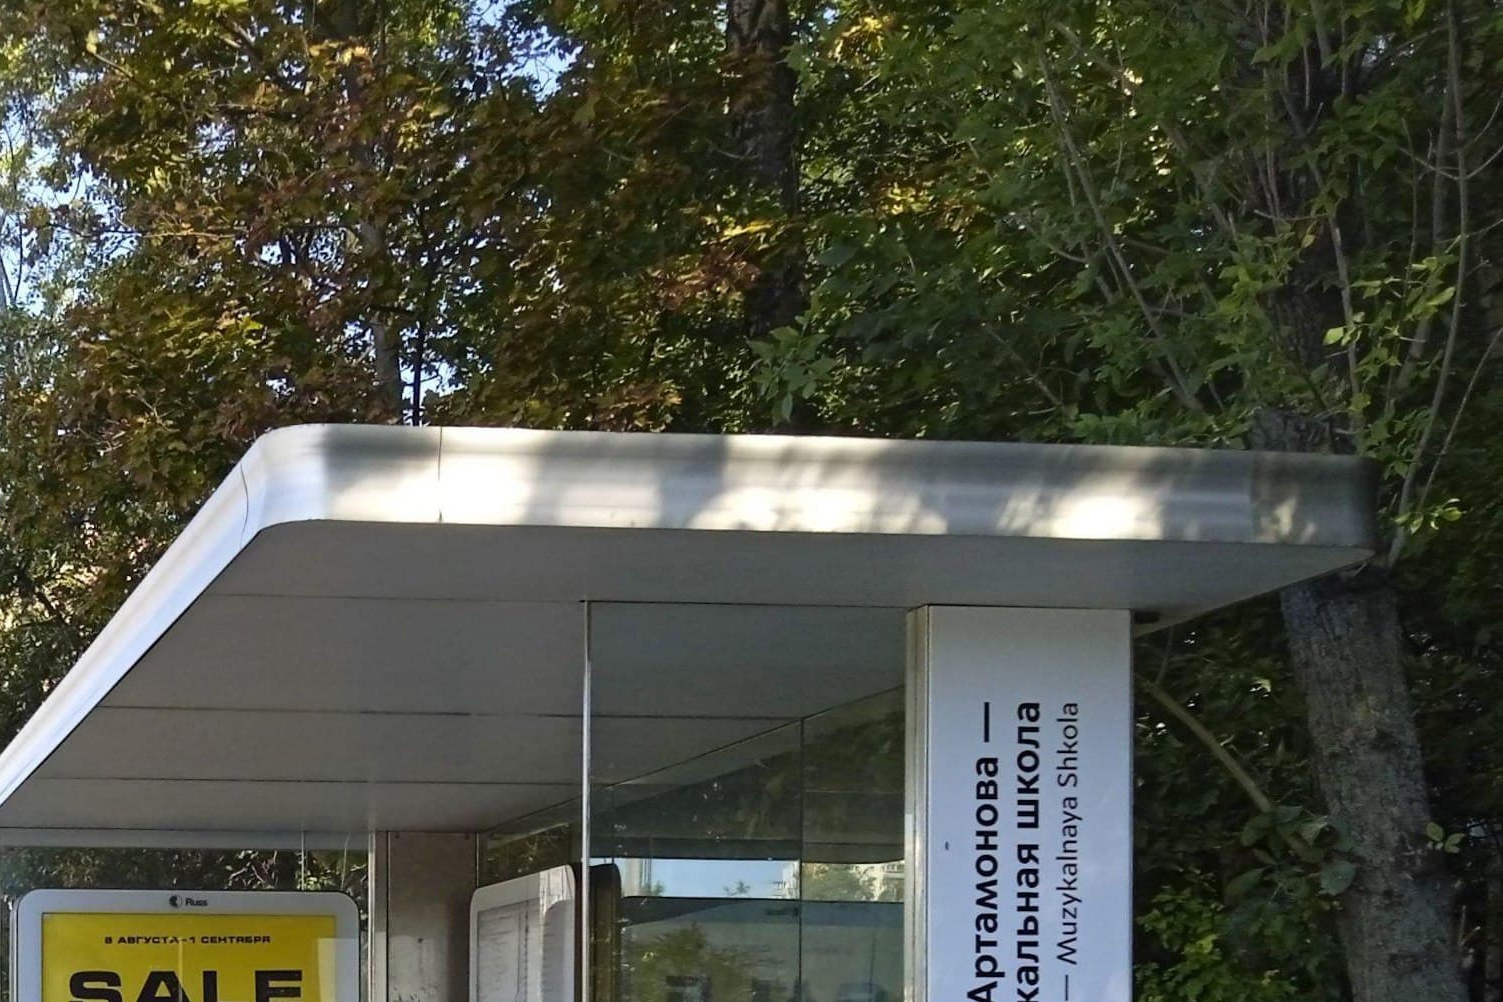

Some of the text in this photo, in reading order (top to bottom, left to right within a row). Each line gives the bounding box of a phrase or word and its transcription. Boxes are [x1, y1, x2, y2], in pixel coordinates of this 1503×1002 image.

[1016, 702, 1041, 829] школа
[1056, 702, 1079, 788] Shkola
[185, 897, 209, 907] Russ
[1055, 797, 1083, 965] Muzykalnaya
[200, 935, 272, 944] СЕНТЯБРЯ
